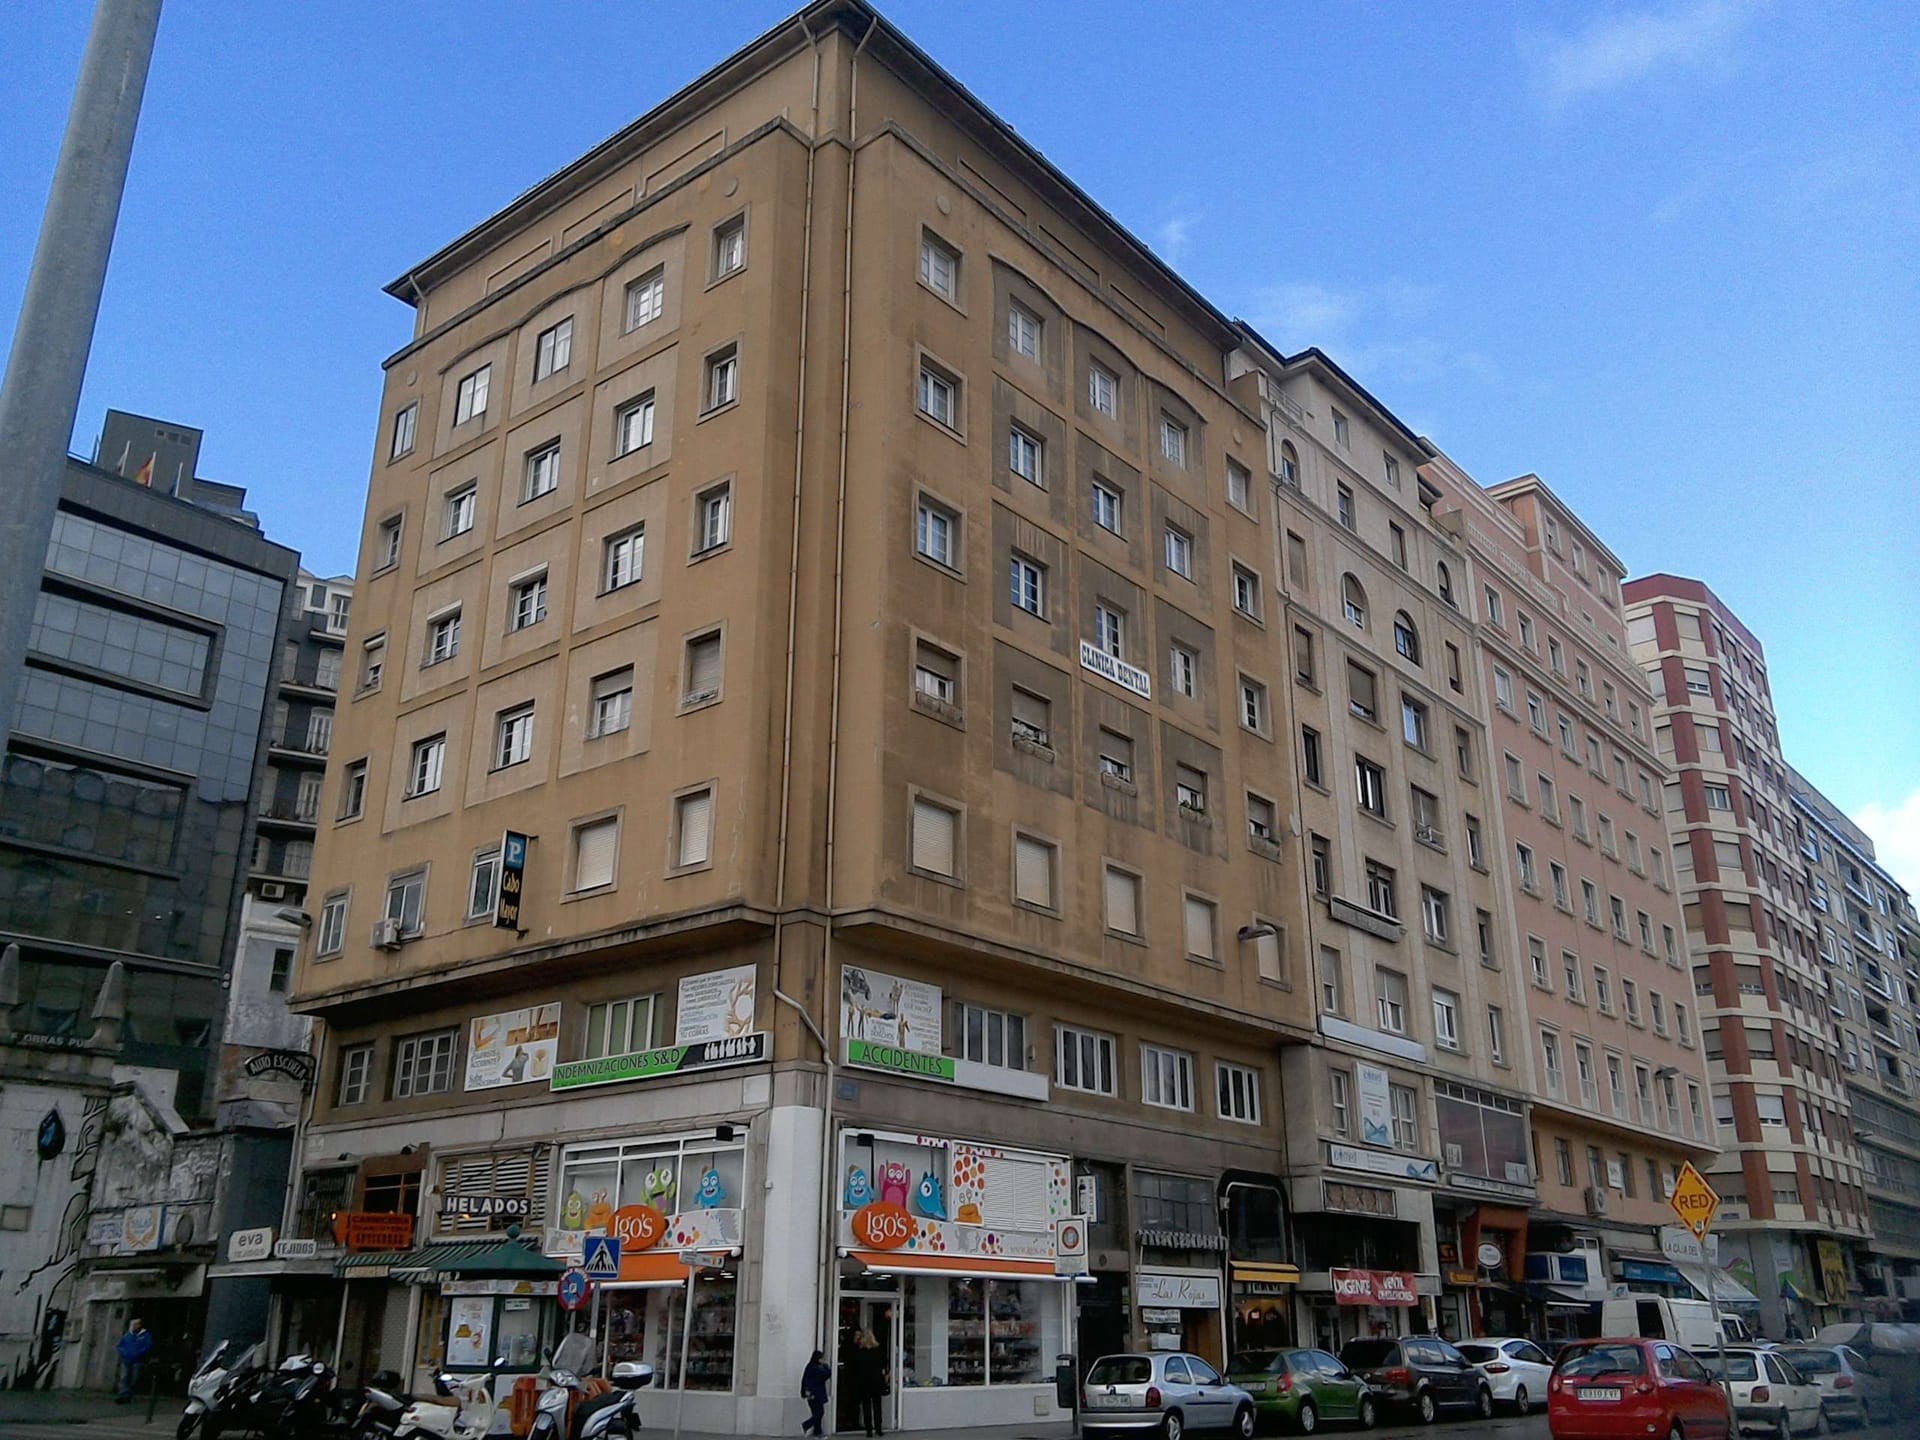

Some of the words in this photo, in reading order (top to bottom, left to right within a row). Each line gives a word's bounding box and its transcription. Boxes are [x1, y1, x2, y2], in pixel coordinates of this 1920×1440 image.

[1117, 662, 1149, 695] DENTAL
[508, 841, 521, 863] P
[503, 870, 520, 893] Cabo
[500, 897, 518, 925] Mayor
[24, 1034, 64, 1046] OBRAS
[249, 1055, 272, 1075] AUTO
[273, 1054, 307, 1080] ESCUELA
[554, 1055, 649, 1080] INDEMNIZACIONES
[654, 1049, 680, 1067] S&D
[862, 1045, 943, 1075] ACCIDENTES
[446, 1197, 529, 1215] HELADOS
[1679, 1194, 1710, 1210] RED
[866, 1211, 908, 1243] Igo's
[238, 1233, 264, 1247] eva
[277, 1242, 315, 1255] TEJIDOS
[1151, 1278, 1174, 1299] Las
[1178, 1278, 1206, 1305] Rojas
[1333, 1278, 1372, 1296] URGENTE
